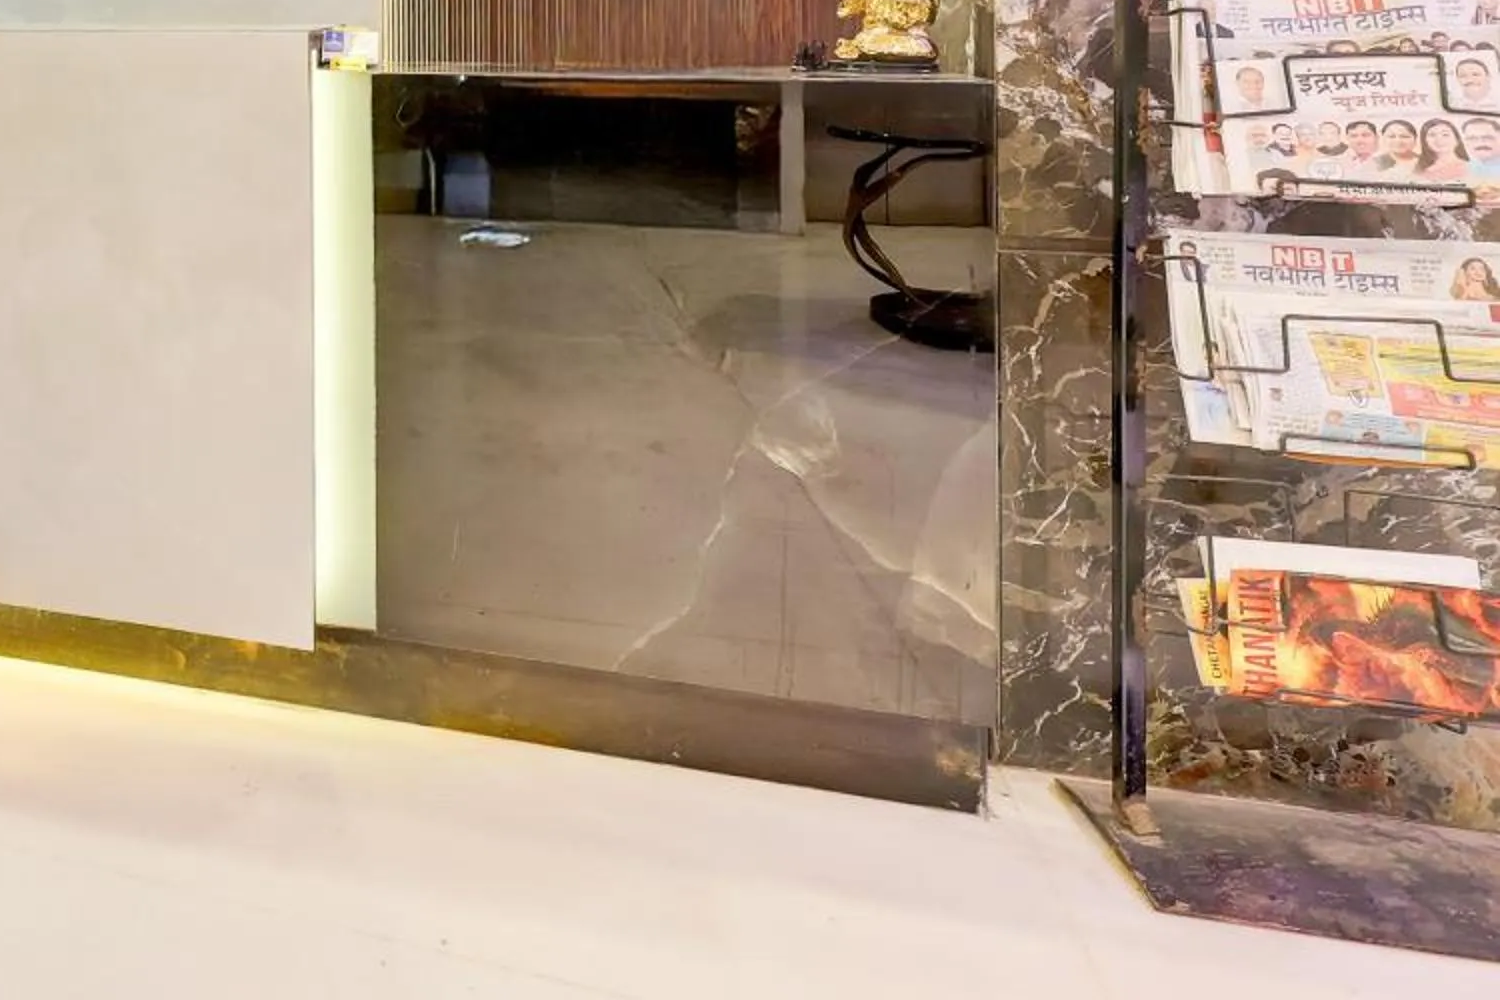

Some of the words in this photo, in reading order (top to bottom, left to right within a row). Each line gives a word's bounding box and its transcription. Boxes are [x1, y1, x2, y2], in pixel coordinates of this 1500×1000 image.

[1260, 13, 1349, 36] नवभारत
[1272, 246, 1354, 274] NBT
[1243, 264, 1326, 288] नवभारत
